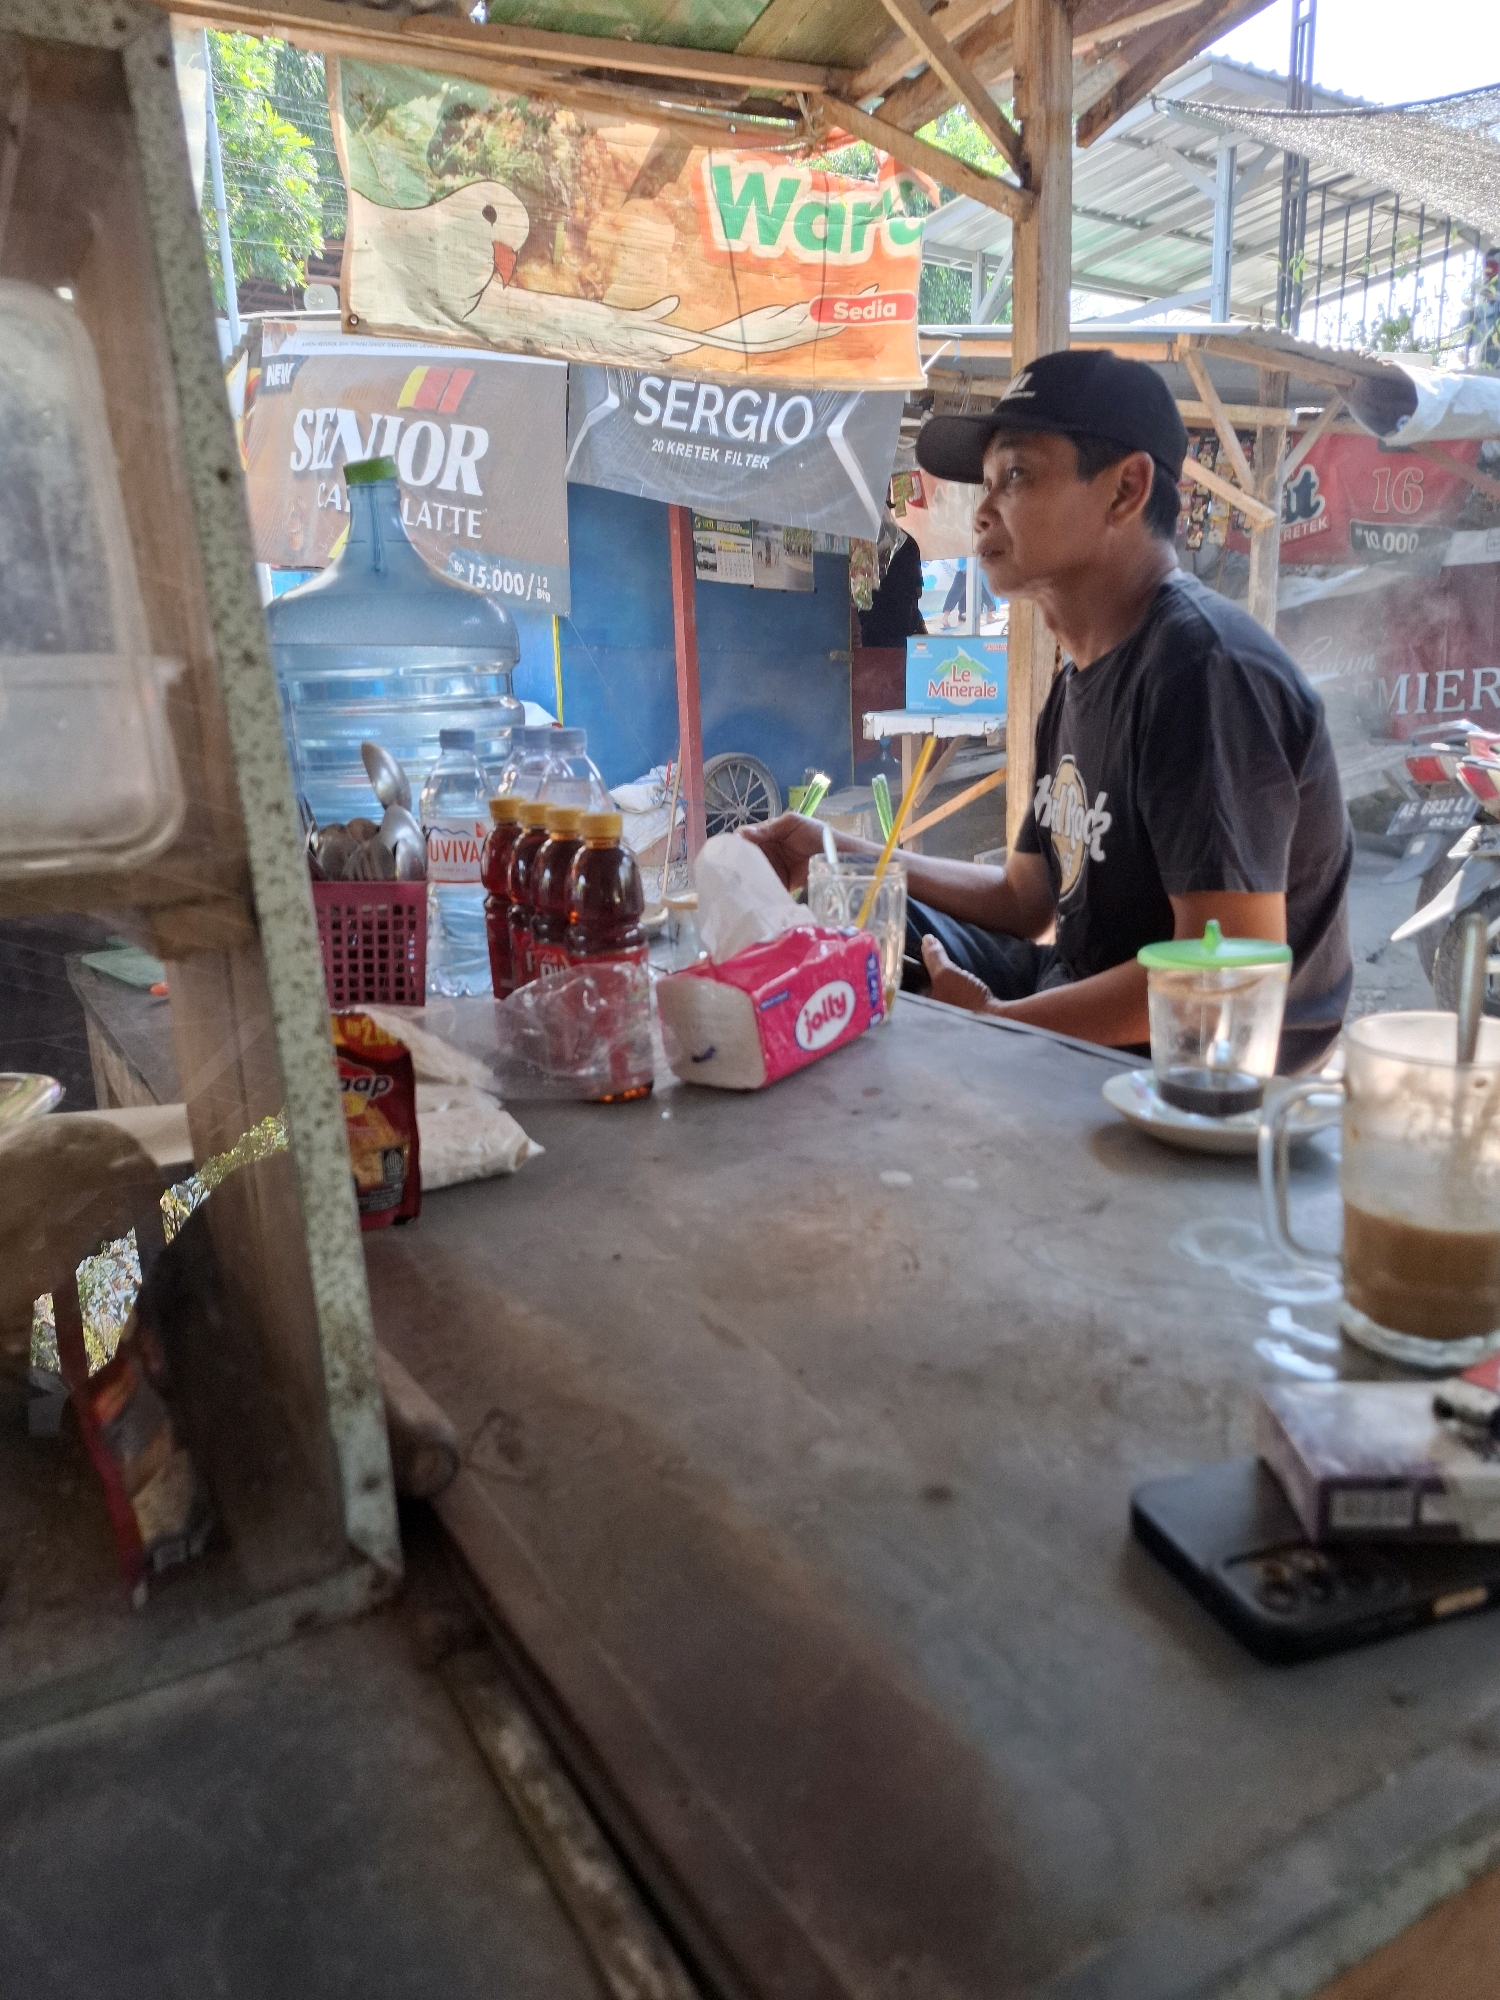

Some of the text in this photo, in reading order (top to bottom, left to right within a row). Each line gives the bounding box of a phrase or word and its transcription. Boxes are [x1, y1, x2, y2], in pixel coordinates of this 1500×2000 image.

[833, 299, 897, 320] Sedia
[265, 363, 295, 387] NEW
[634, 376, 814, 446] SERGIO
[290, 407, 490, 497] SENIOR
[651, 438, 770, 470] 20 KRETEK FILTER
[1372, 466, 1424, 515] 16
[402, 498, 482, 539] LATTE
[927, 680, 997, 699] Minerale
[951, 664, 971, 682] Le
[804, 991, 847, 1044] jolly
